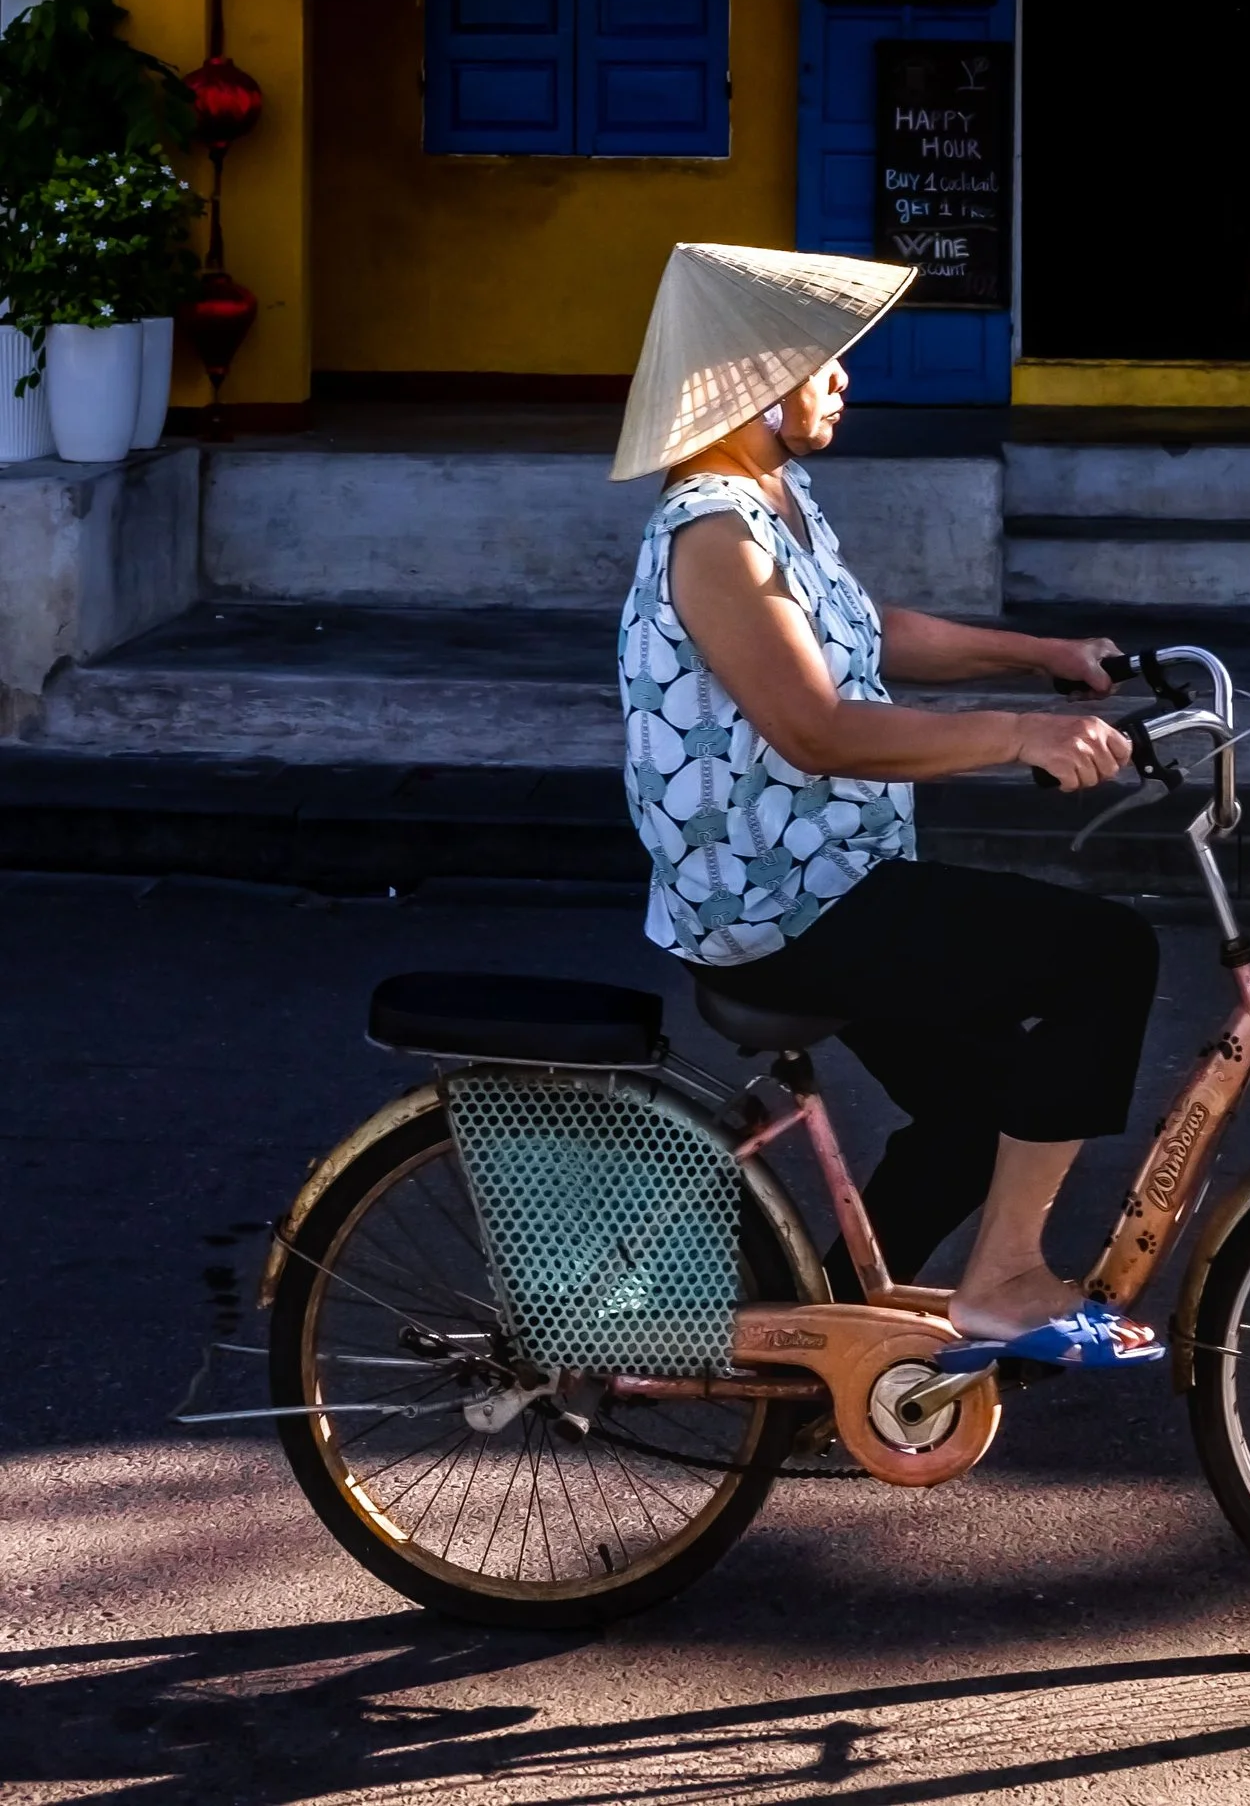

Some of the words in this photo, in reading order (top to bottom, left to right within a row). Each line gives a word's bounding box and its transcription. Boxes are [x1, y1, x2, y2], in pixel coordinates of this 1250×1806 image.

[896, 107, 976, 133] HAPPY
[922, 136, 982, 160] HOUR
[924, 171, 937, 191] 1
[938, 197, 953, 216] 1
[1146, 1101, 1210, 1211] Windows
